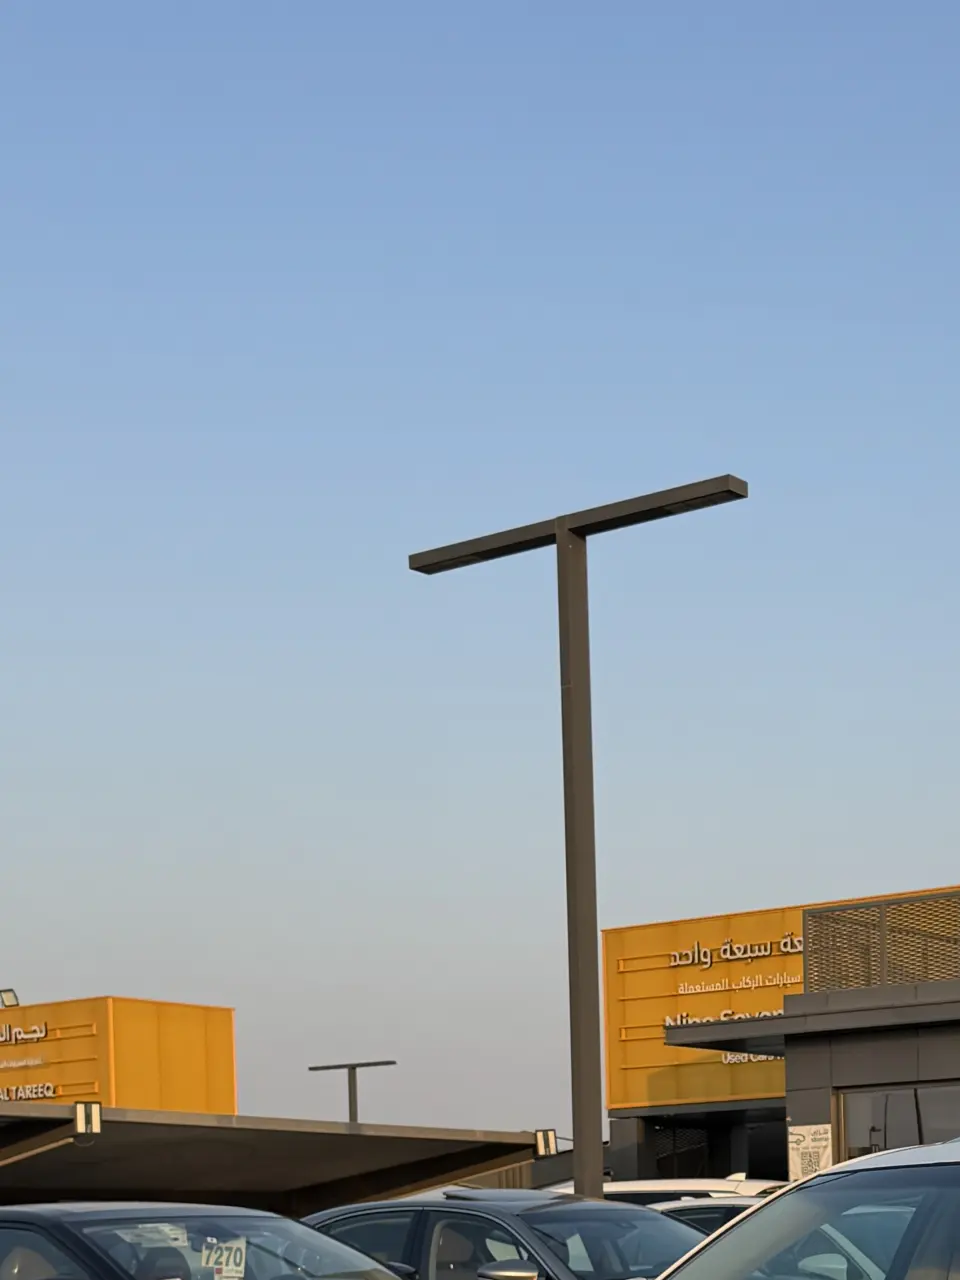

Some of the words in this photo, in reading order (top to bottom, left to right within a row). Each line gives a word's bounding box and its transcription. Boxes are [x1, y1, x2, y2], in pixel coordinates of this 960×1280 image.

[670, 941, 711, 969] واحد
[720, 938, 771, 963] سبعة
[678, 978, 728, 994] المستعملة
[722, 1052, 748, 1064] Used
[10, 1083, 56, 1101] TAREEQ
[204, 1245, 244, 1268] 7270
